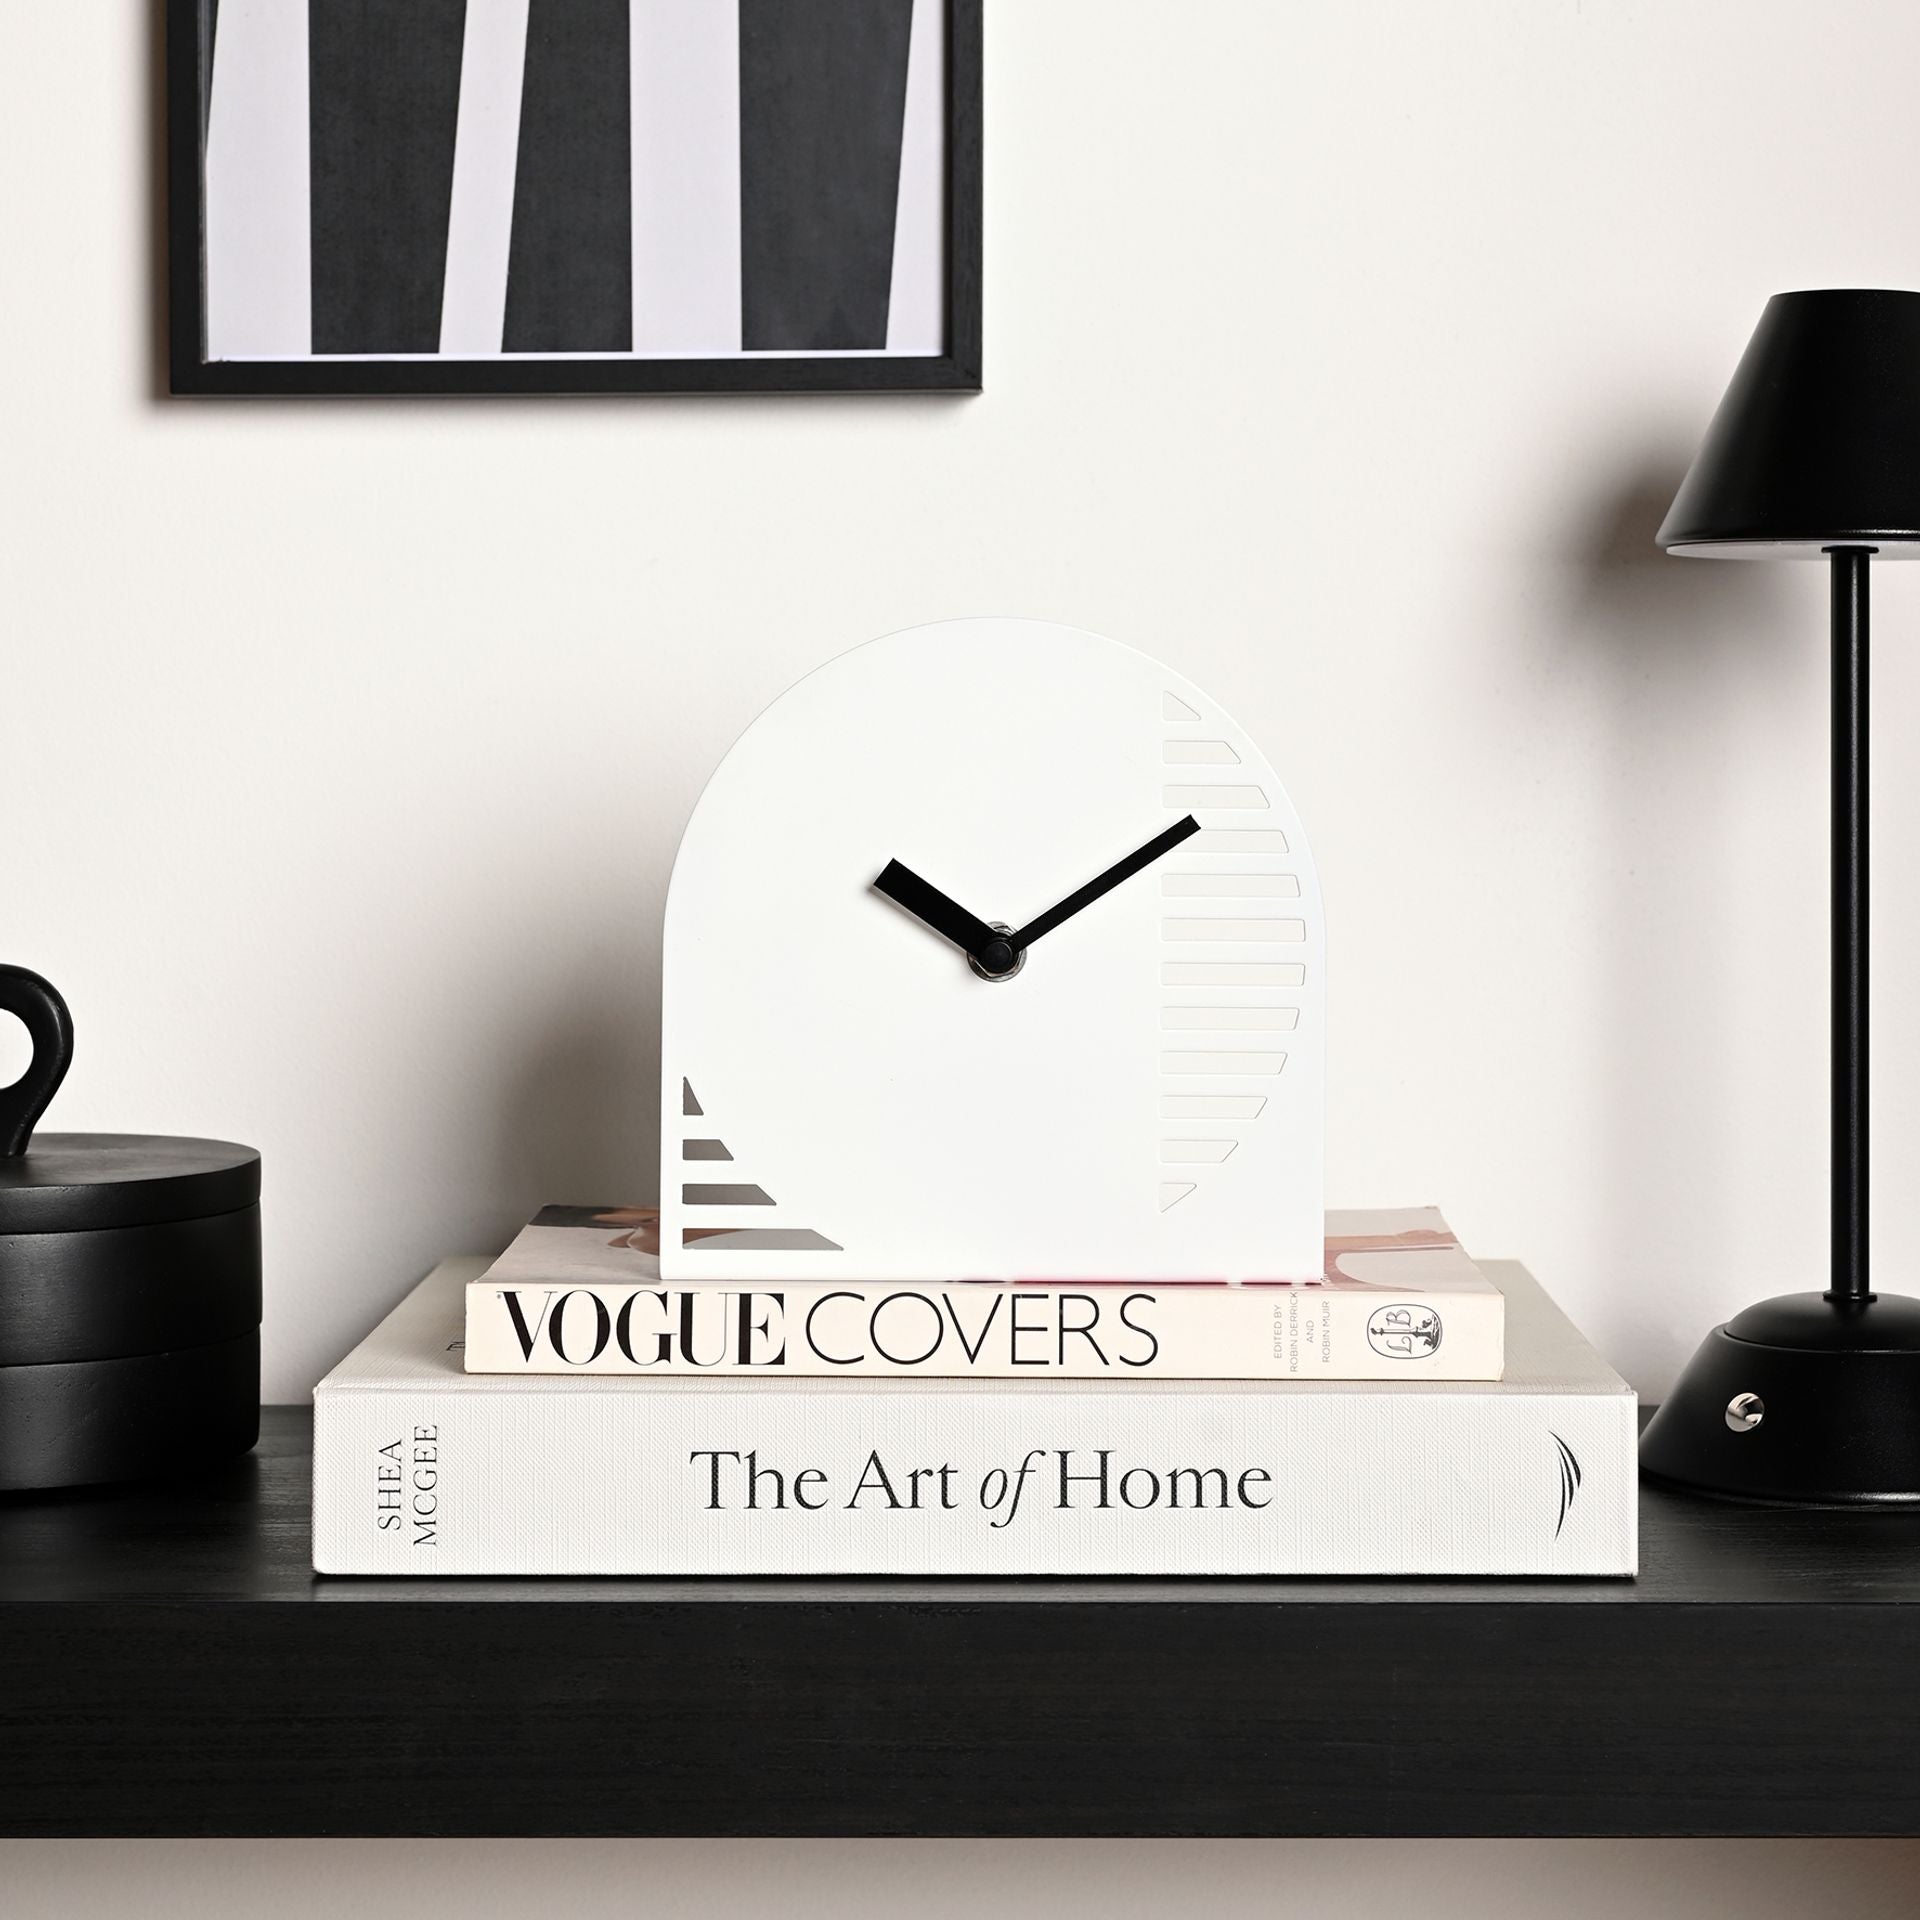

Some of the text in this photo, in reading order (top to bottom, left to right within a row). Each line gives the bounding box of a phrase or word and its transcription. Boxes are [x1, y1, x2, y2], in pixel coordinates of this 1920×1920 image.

[501, 1289, 1159, 1367] VOGUE COVERS
[1273, 1304, 1283, 1359] EDITED BY
[1289, 1292, 1299, 1373] ROBIN DERRICK
[1305, 1320, 1315, 1344] AND
[1321, 1301, 1331, 1363] ROBIN MUIR
[377, 1439, 402, 1531] SHEA
[412, 1425, 438, 1546] MCGEE
[689, 1449, 1274, 1529] The Art of Home
